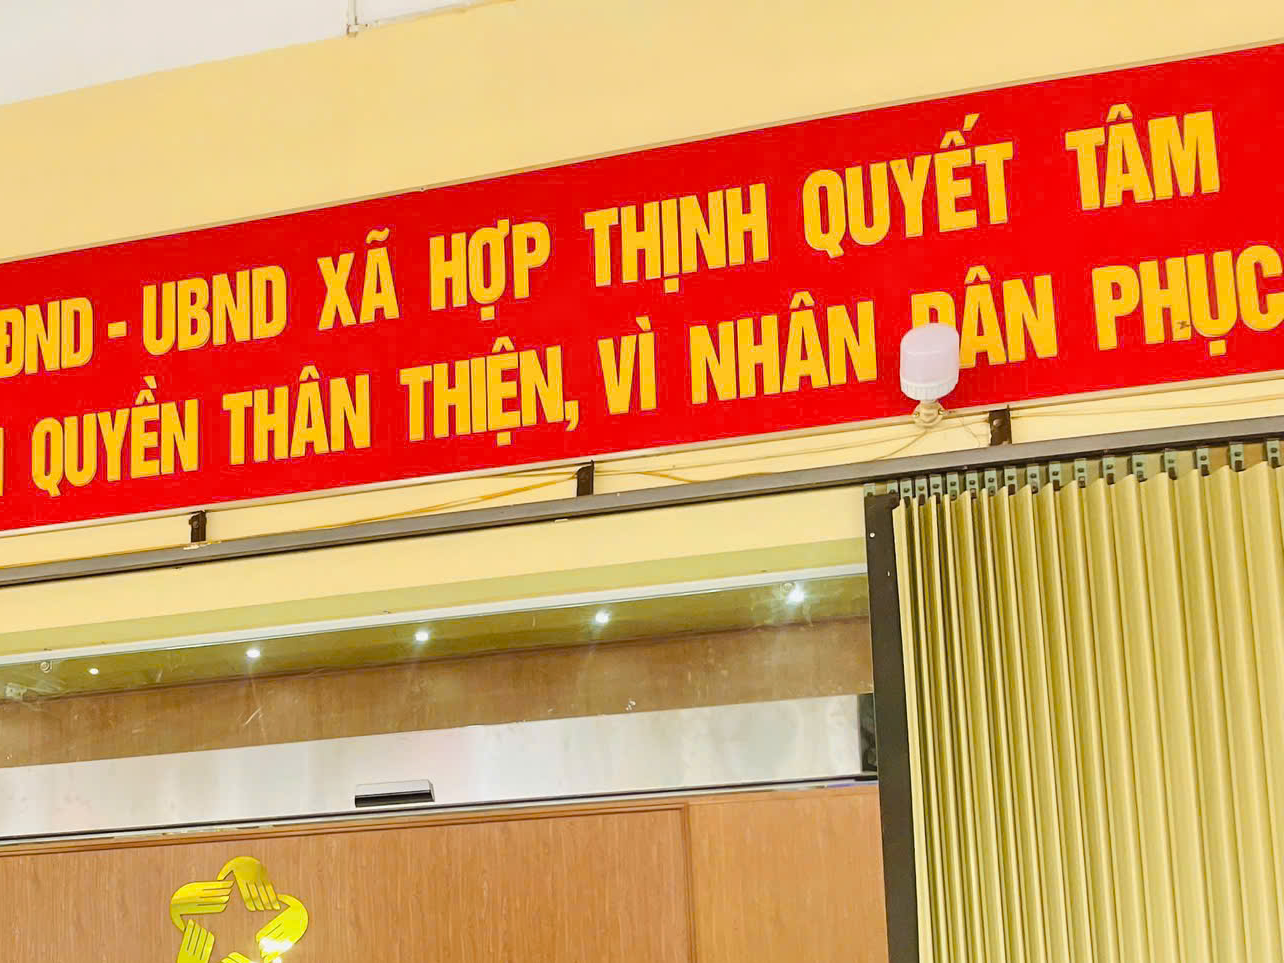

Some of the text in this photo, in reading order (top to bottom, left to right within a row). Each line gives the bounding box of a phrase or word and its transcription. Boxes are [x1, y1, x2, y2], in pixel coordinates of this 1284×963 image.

[143, 265, 289, 355] UBND
[317, 227, 401, 330] XÃ
[430, 218, 551, 321] HỢP
[583, 183, 771, 294] THỊNH
[802, 113, 1014, 258] QUYẾT
[1065, 103, 1220, 211] TÂM
[32, 376, 199, 497] QUYỀN
[223, 366, 371, 465] THÂN
[400, 337, 579, 446] THIỆN,
[598, 316, 657, 415] VÌ
[689, 291, 877, 404] NHÂN
[1092, 245, 1284, 356] PHỤC
